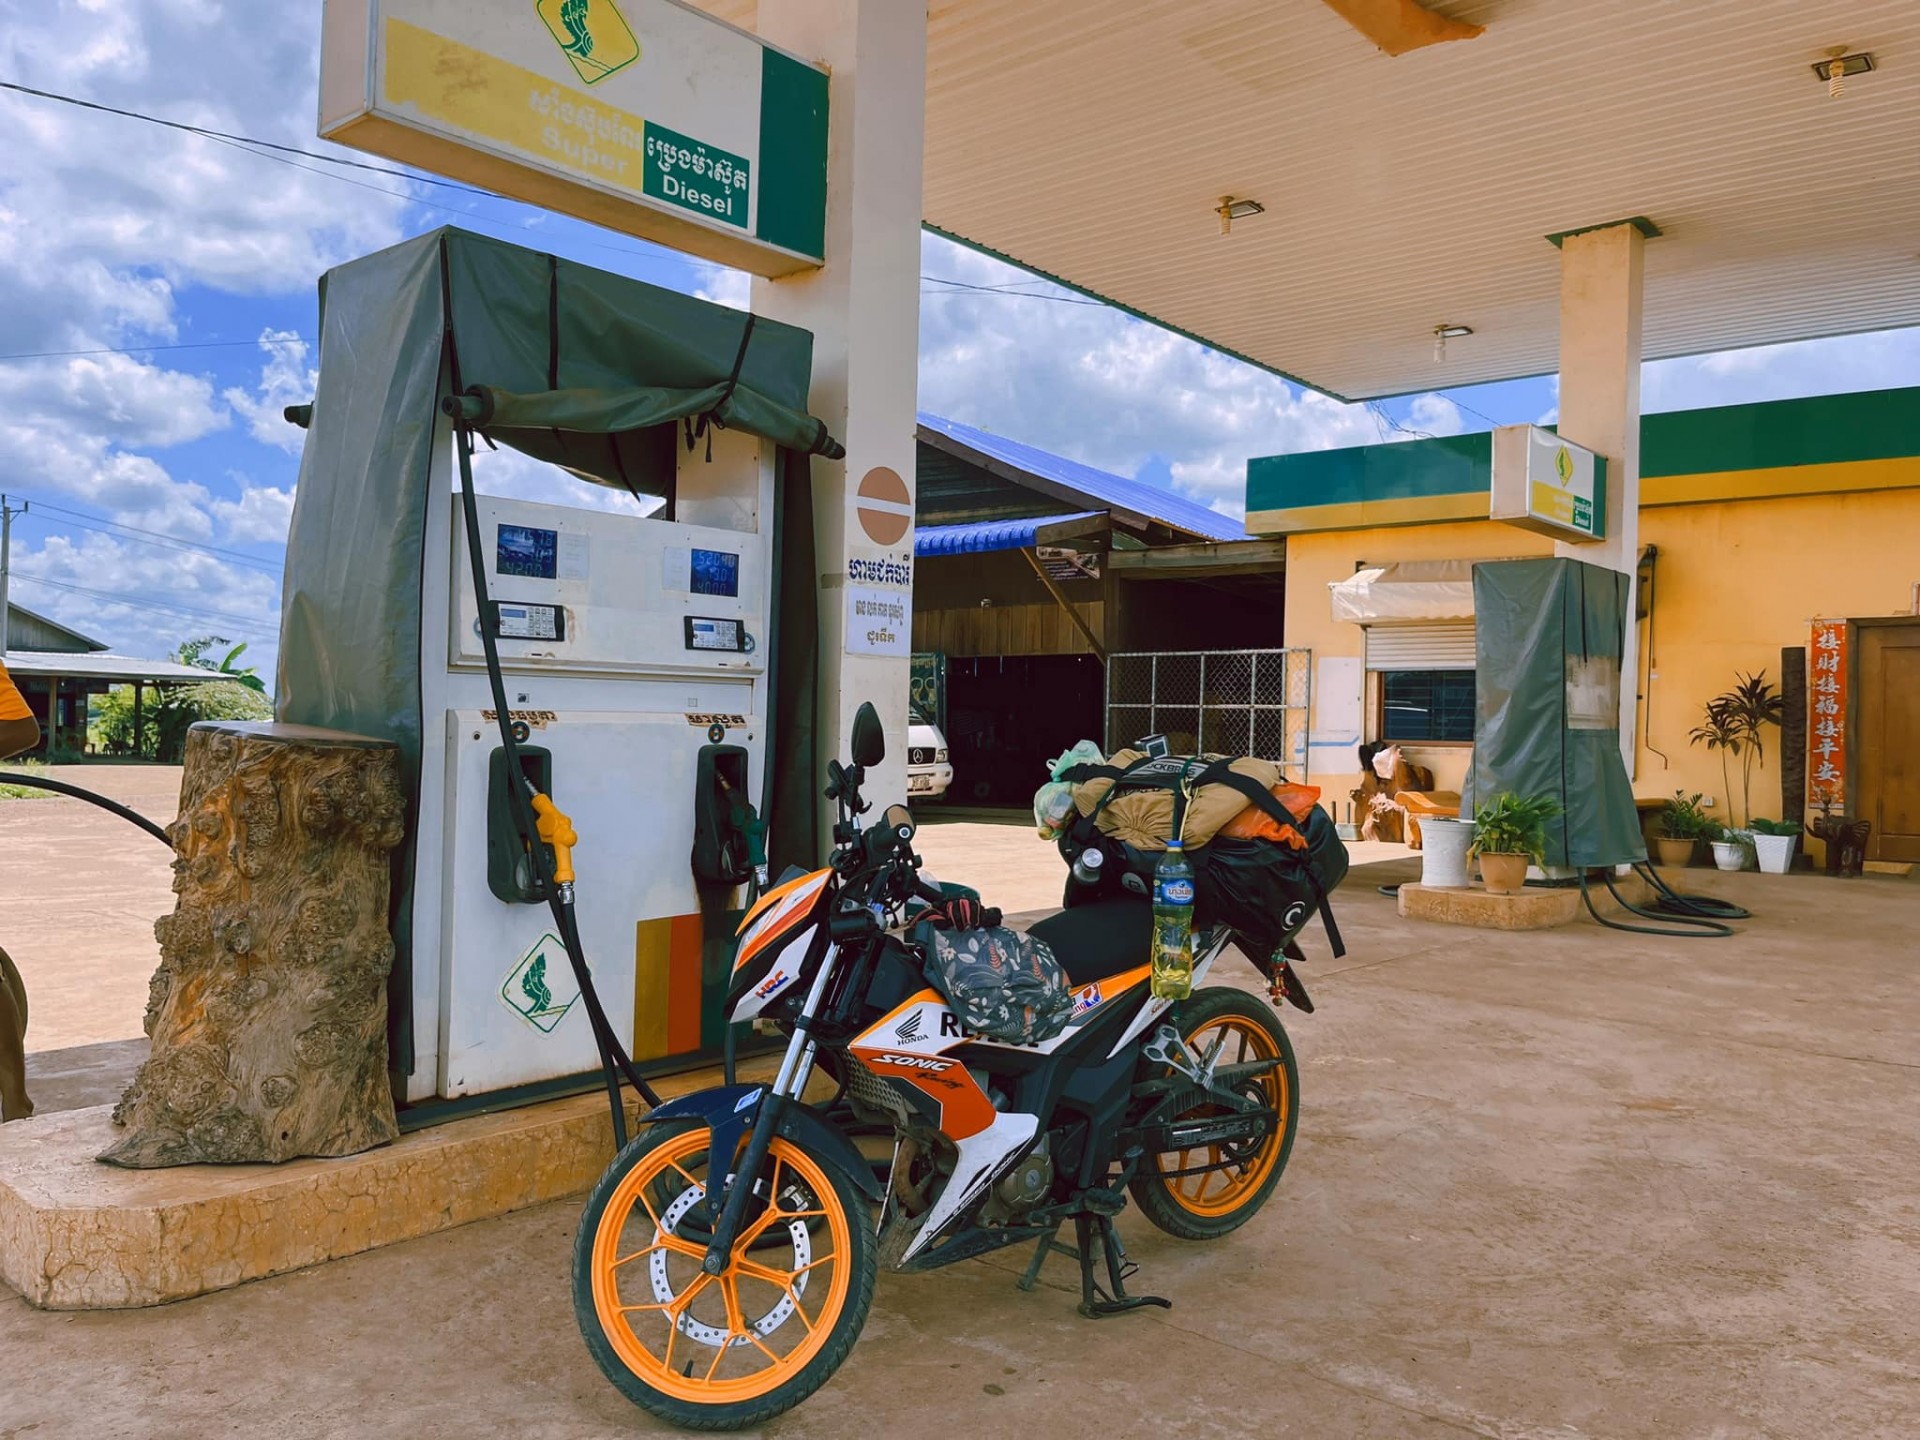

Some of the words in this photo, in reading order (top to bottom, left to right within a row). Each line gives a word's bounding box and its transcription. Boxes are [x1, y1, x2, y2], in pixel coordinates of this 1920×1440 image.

[541, 124, 629, 175] Super
[662, 174, 733, 216] Diesel
[1813, 628, 1842, 783] 接財接福接平安
[755, 970, 790, 999] HRC
[897, 1033, 930, 1046] HONDA
[871, 1053, 954, 1072] SONIC
